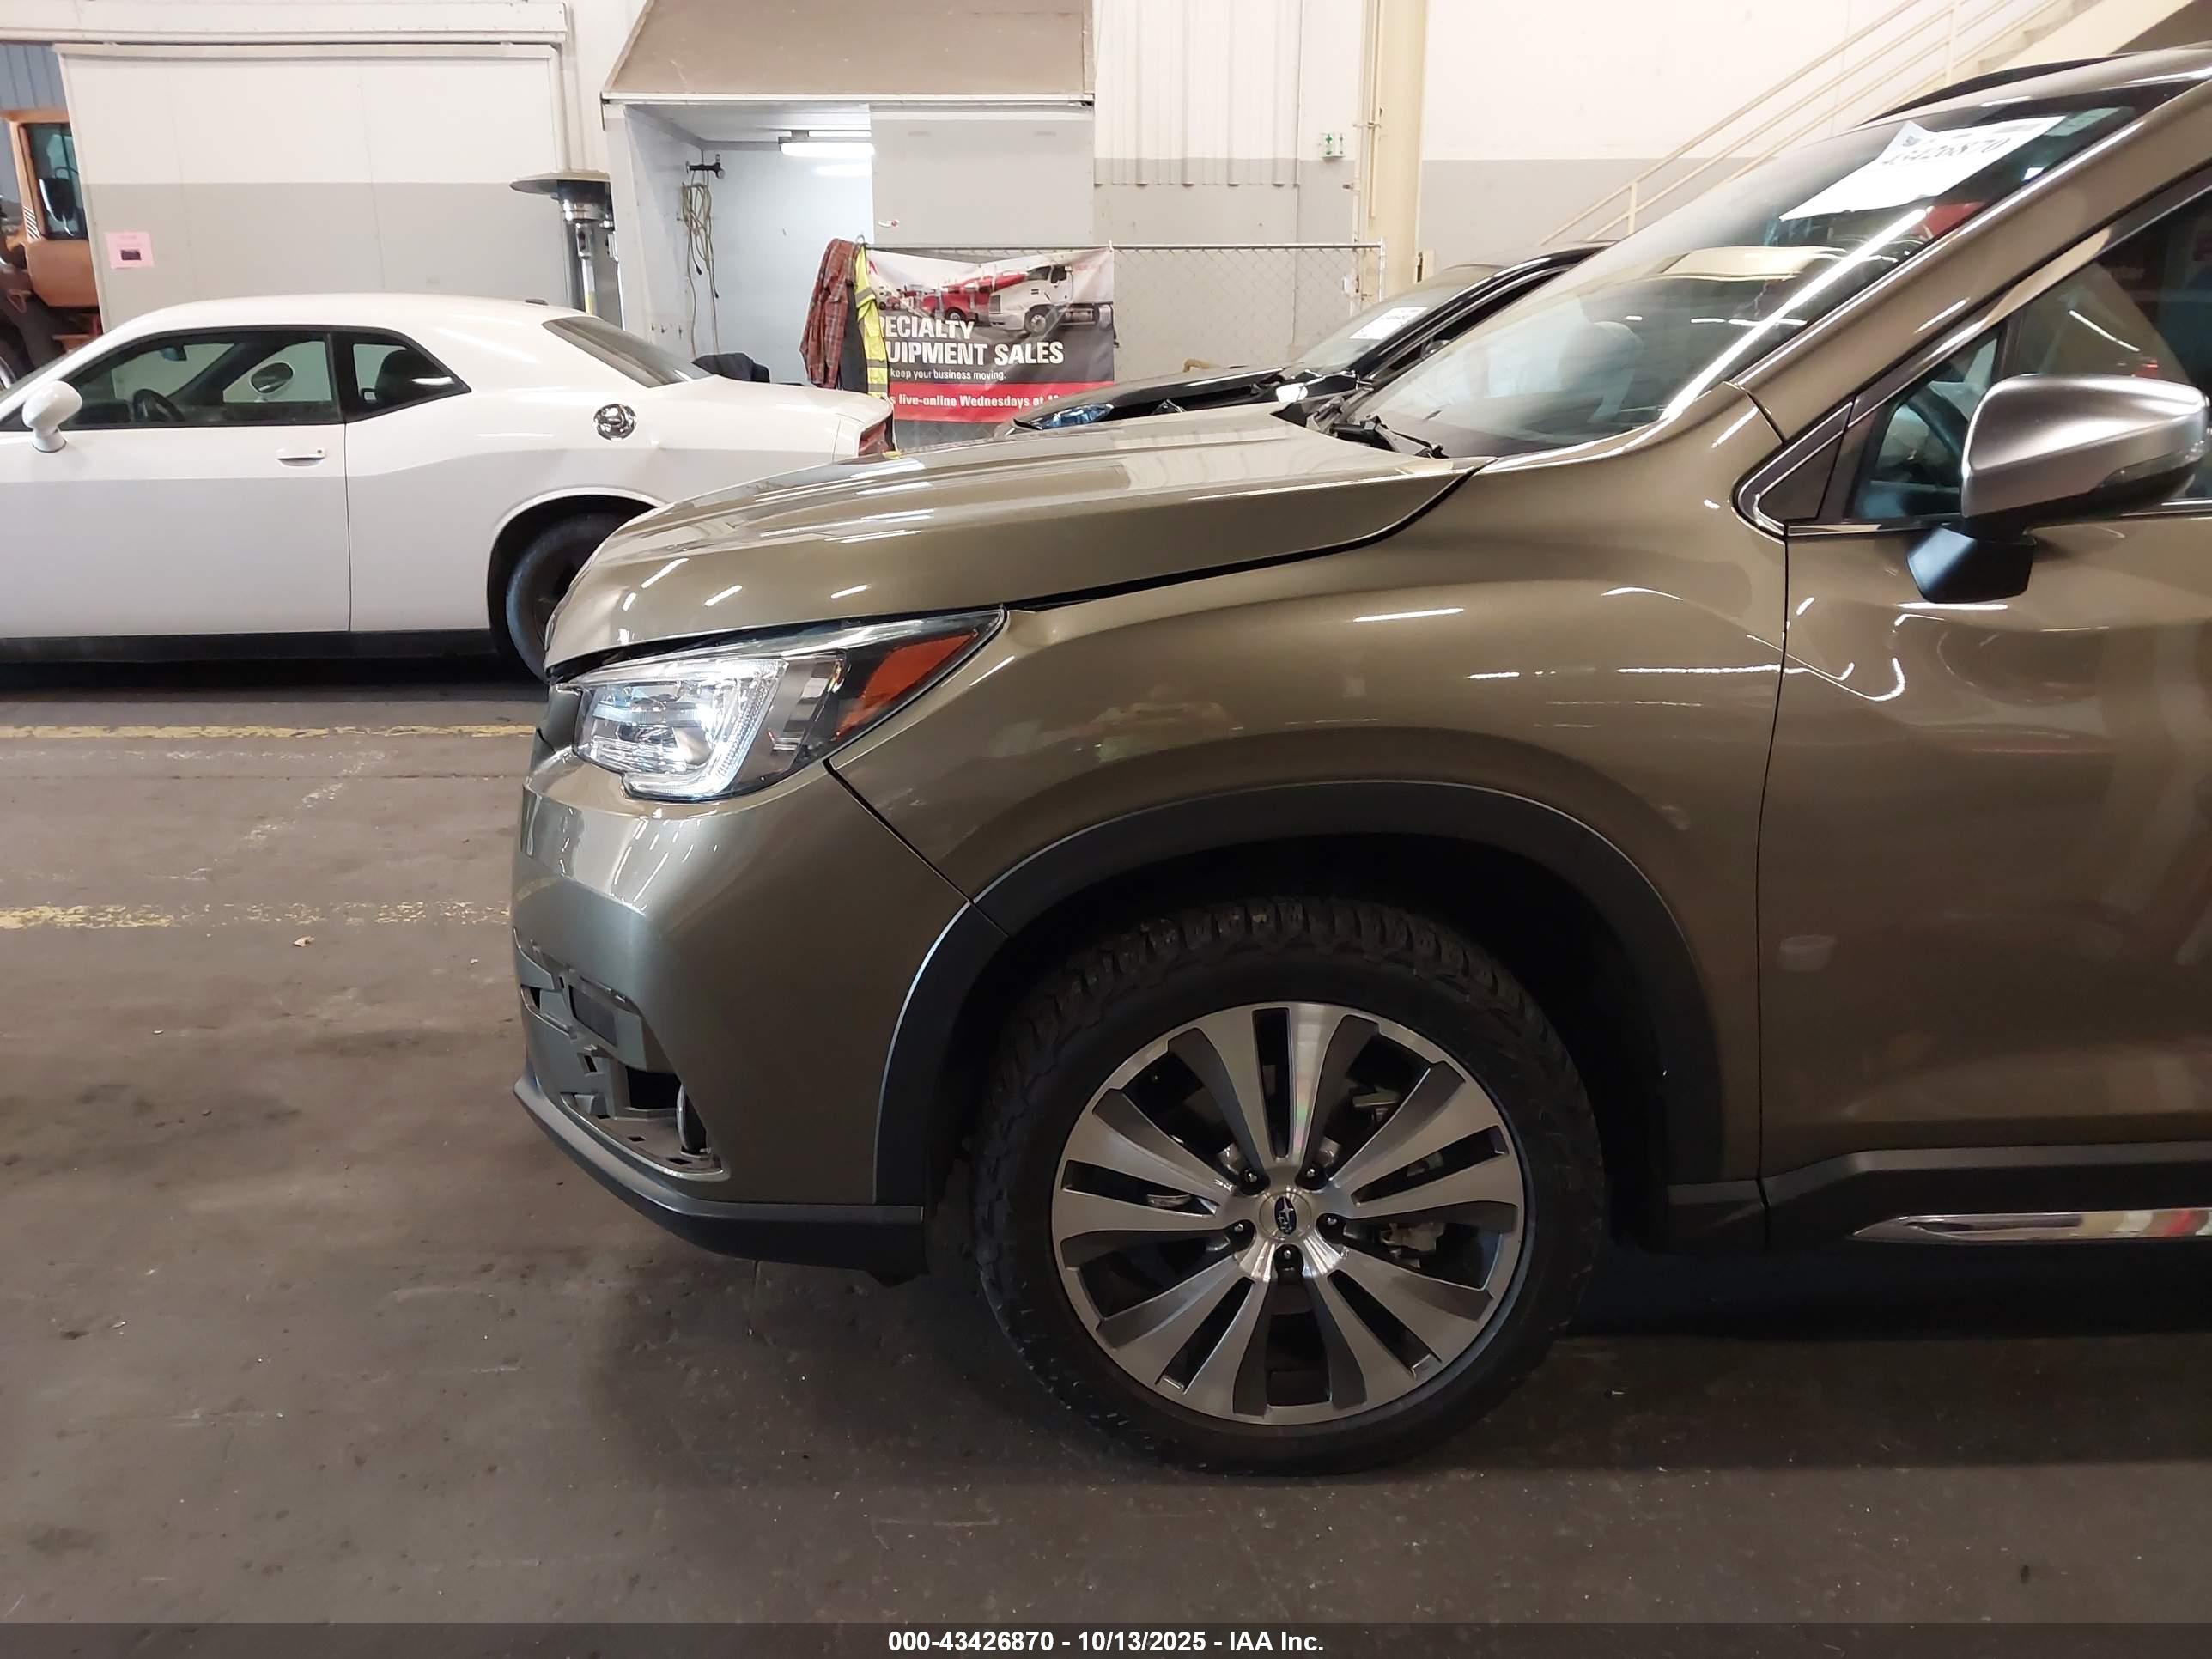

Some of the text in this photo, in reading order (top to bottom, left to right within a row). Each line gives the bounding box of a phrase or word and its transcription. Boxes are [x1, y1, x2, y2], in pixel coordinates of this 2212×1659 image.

[887, 341, 1064, 366] UIPMENT SALES
[890, 368, 1007, 380] keep your business moving.
[899, 394, 957, 407] live-online
[960, 395, 1030, 409] Wednesdays
